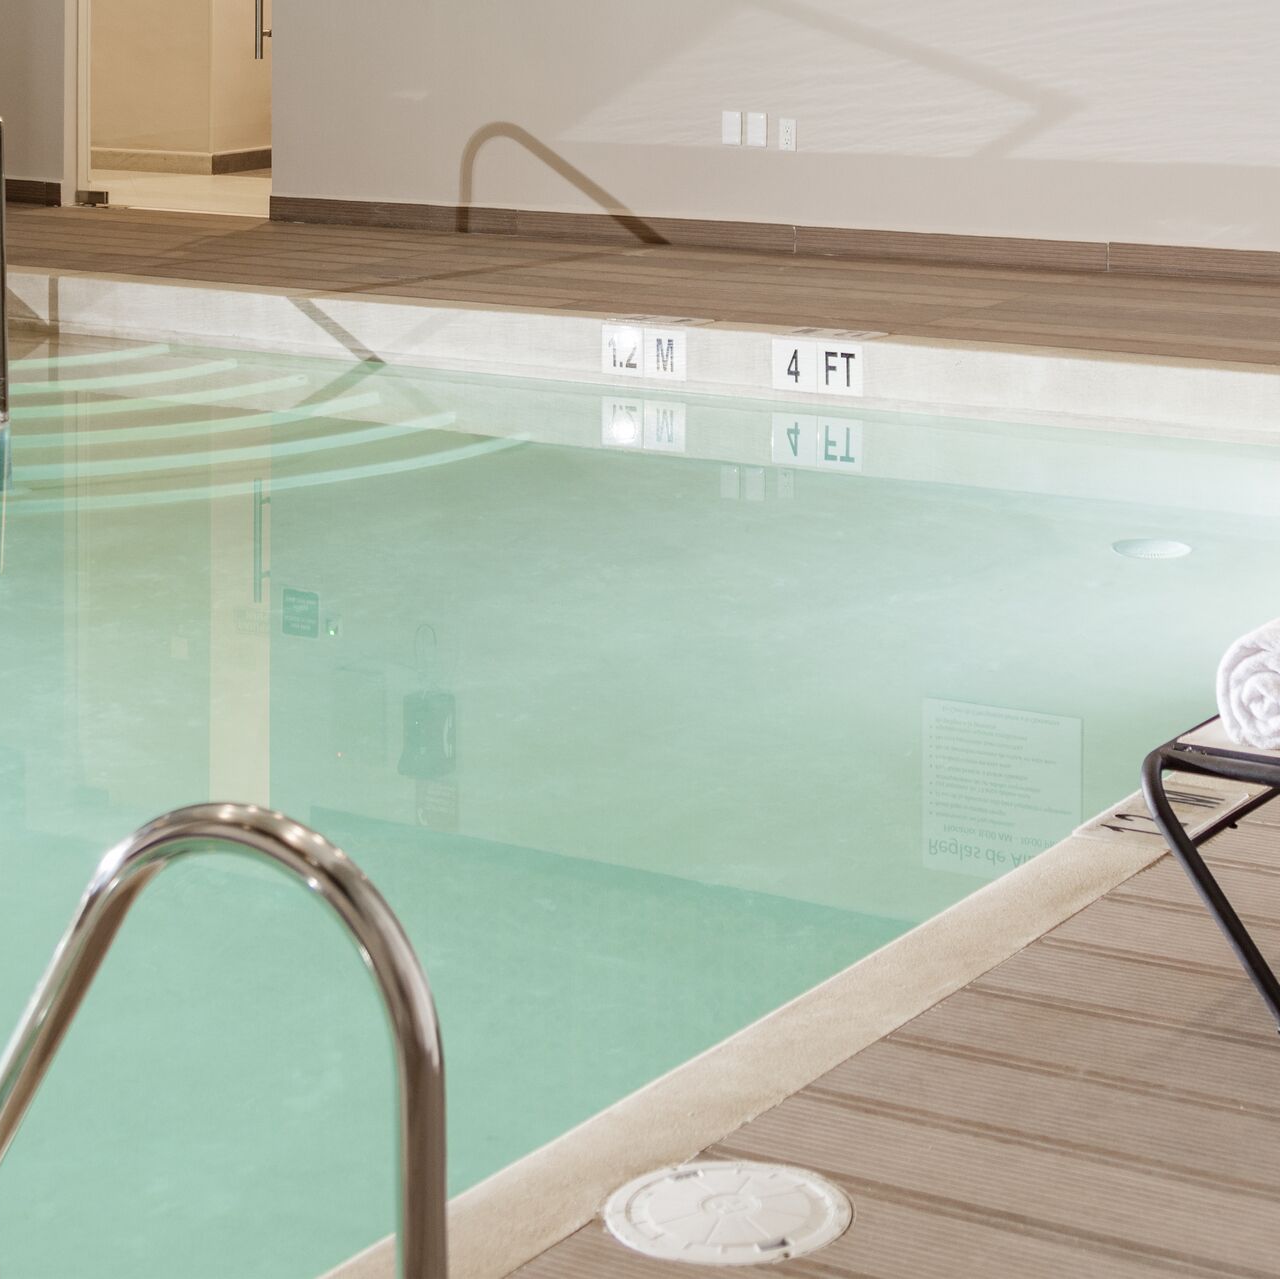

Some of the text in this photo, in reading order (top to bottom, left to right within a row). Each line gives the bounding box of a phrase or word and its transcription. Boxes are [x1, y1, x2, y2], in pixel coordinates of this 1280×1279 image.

[656, 337, 674, 373] M
[787, 349, 856, 387] 4 FT
